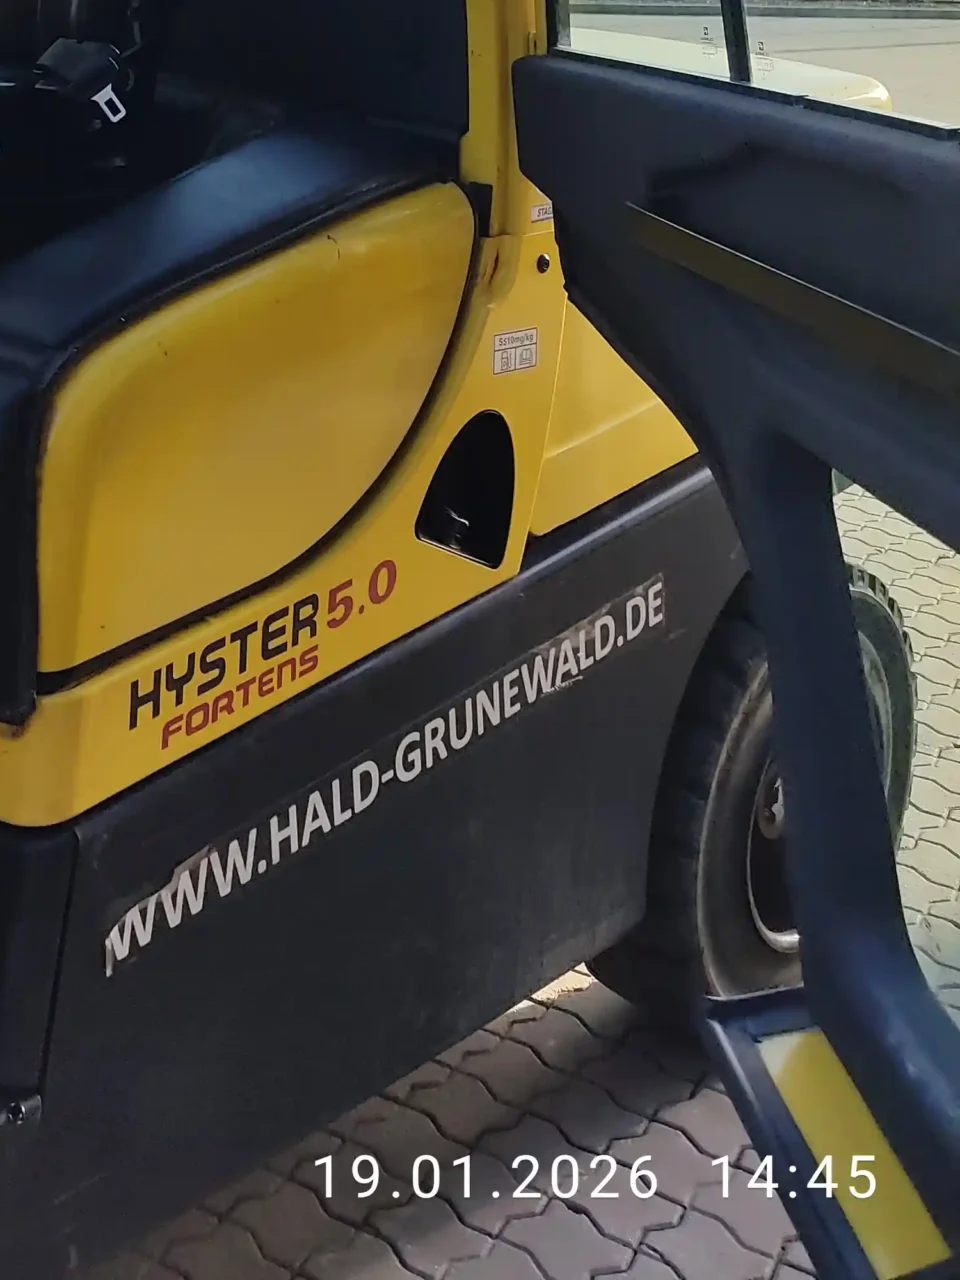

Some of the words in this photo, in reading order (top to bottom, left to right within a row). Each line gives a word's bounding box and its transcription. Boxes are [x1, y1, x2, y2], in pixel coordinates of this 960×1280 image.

[129, 593, 319, 731] HYSTER
[326, 559, 397, 629] 5.0
[161, 644, 319, 750] FORTENS
[105, 581, 664, 978] WWW.HALD-GRUNEWALD.DE
